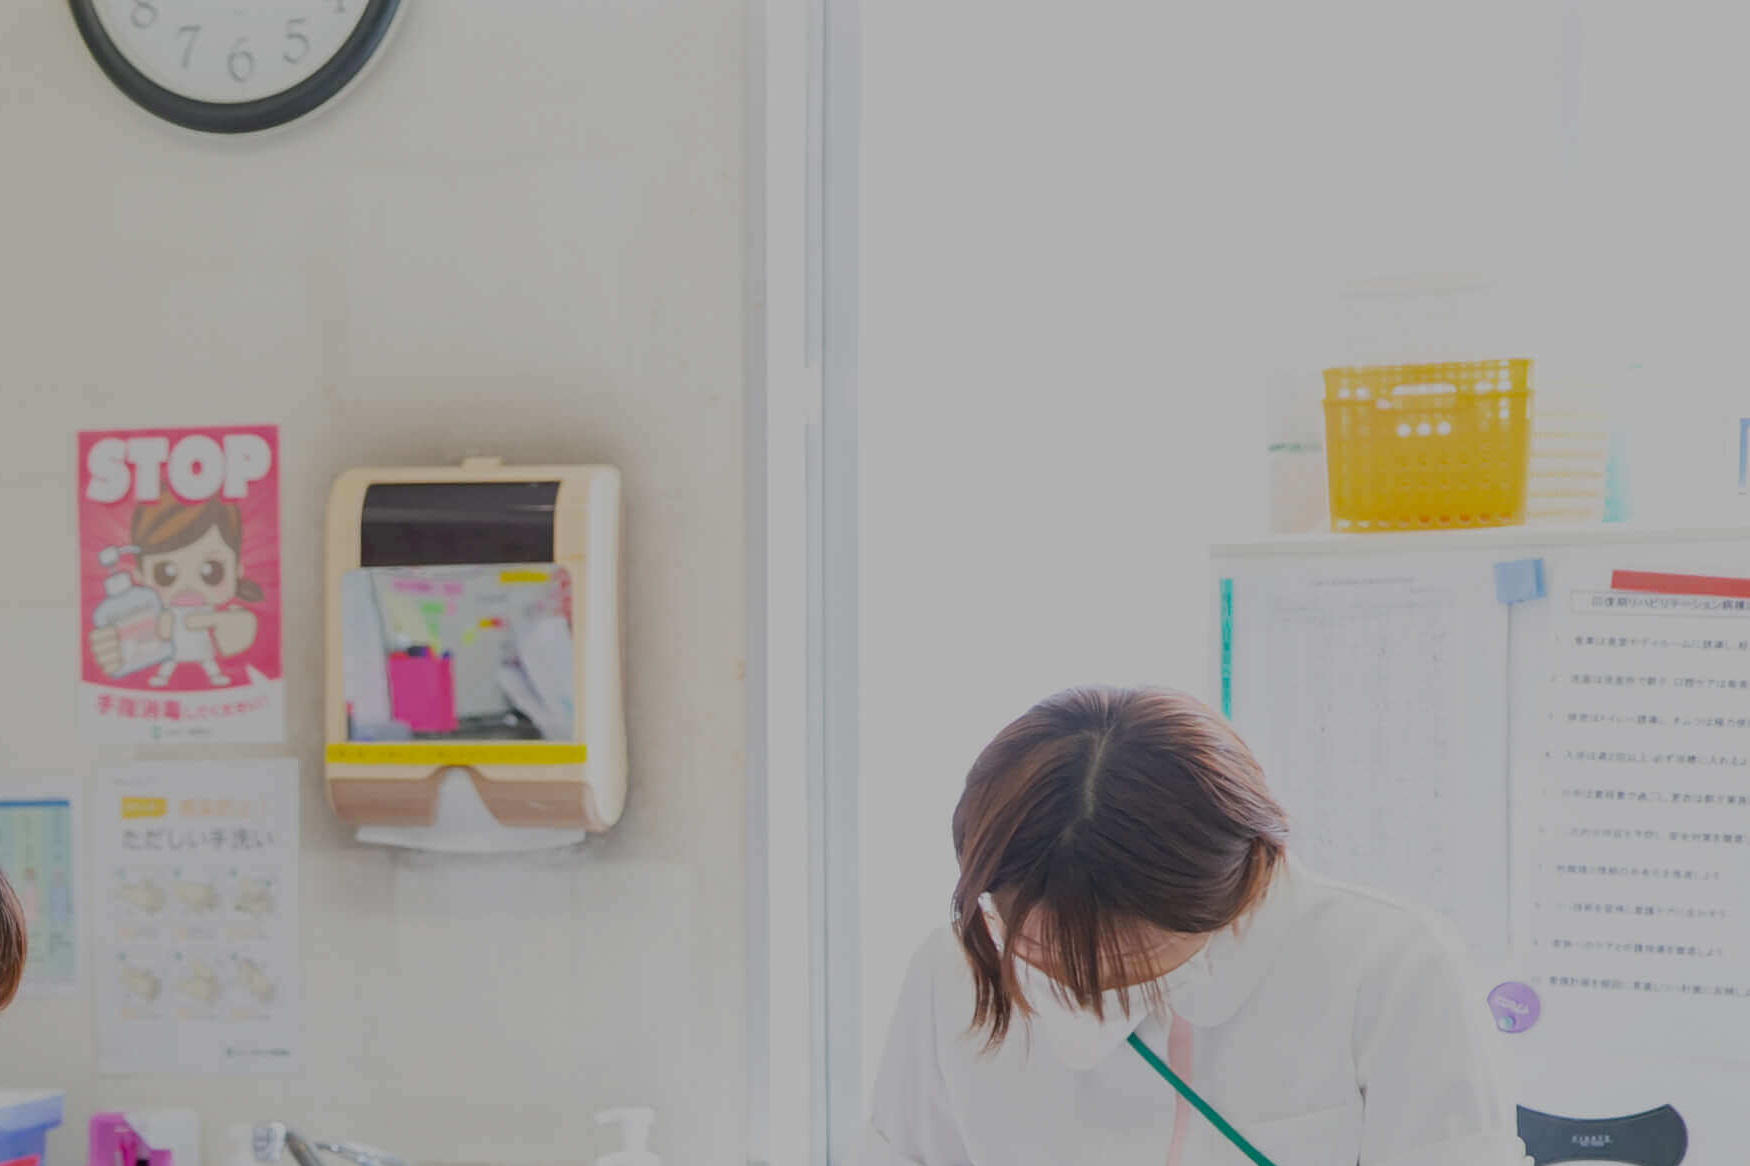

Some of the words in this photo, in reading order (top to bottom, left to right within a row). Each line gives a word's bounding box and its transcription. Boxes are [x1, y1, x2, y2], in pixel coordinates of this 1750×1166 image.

[177, 25, 202, 70] 7
[227, 37, 255, 83] 6
[283, 19, 309, 64] 5
[85, 433, 272, 504] STOP
[121, 827, 275, 852] ただしい手洗い
